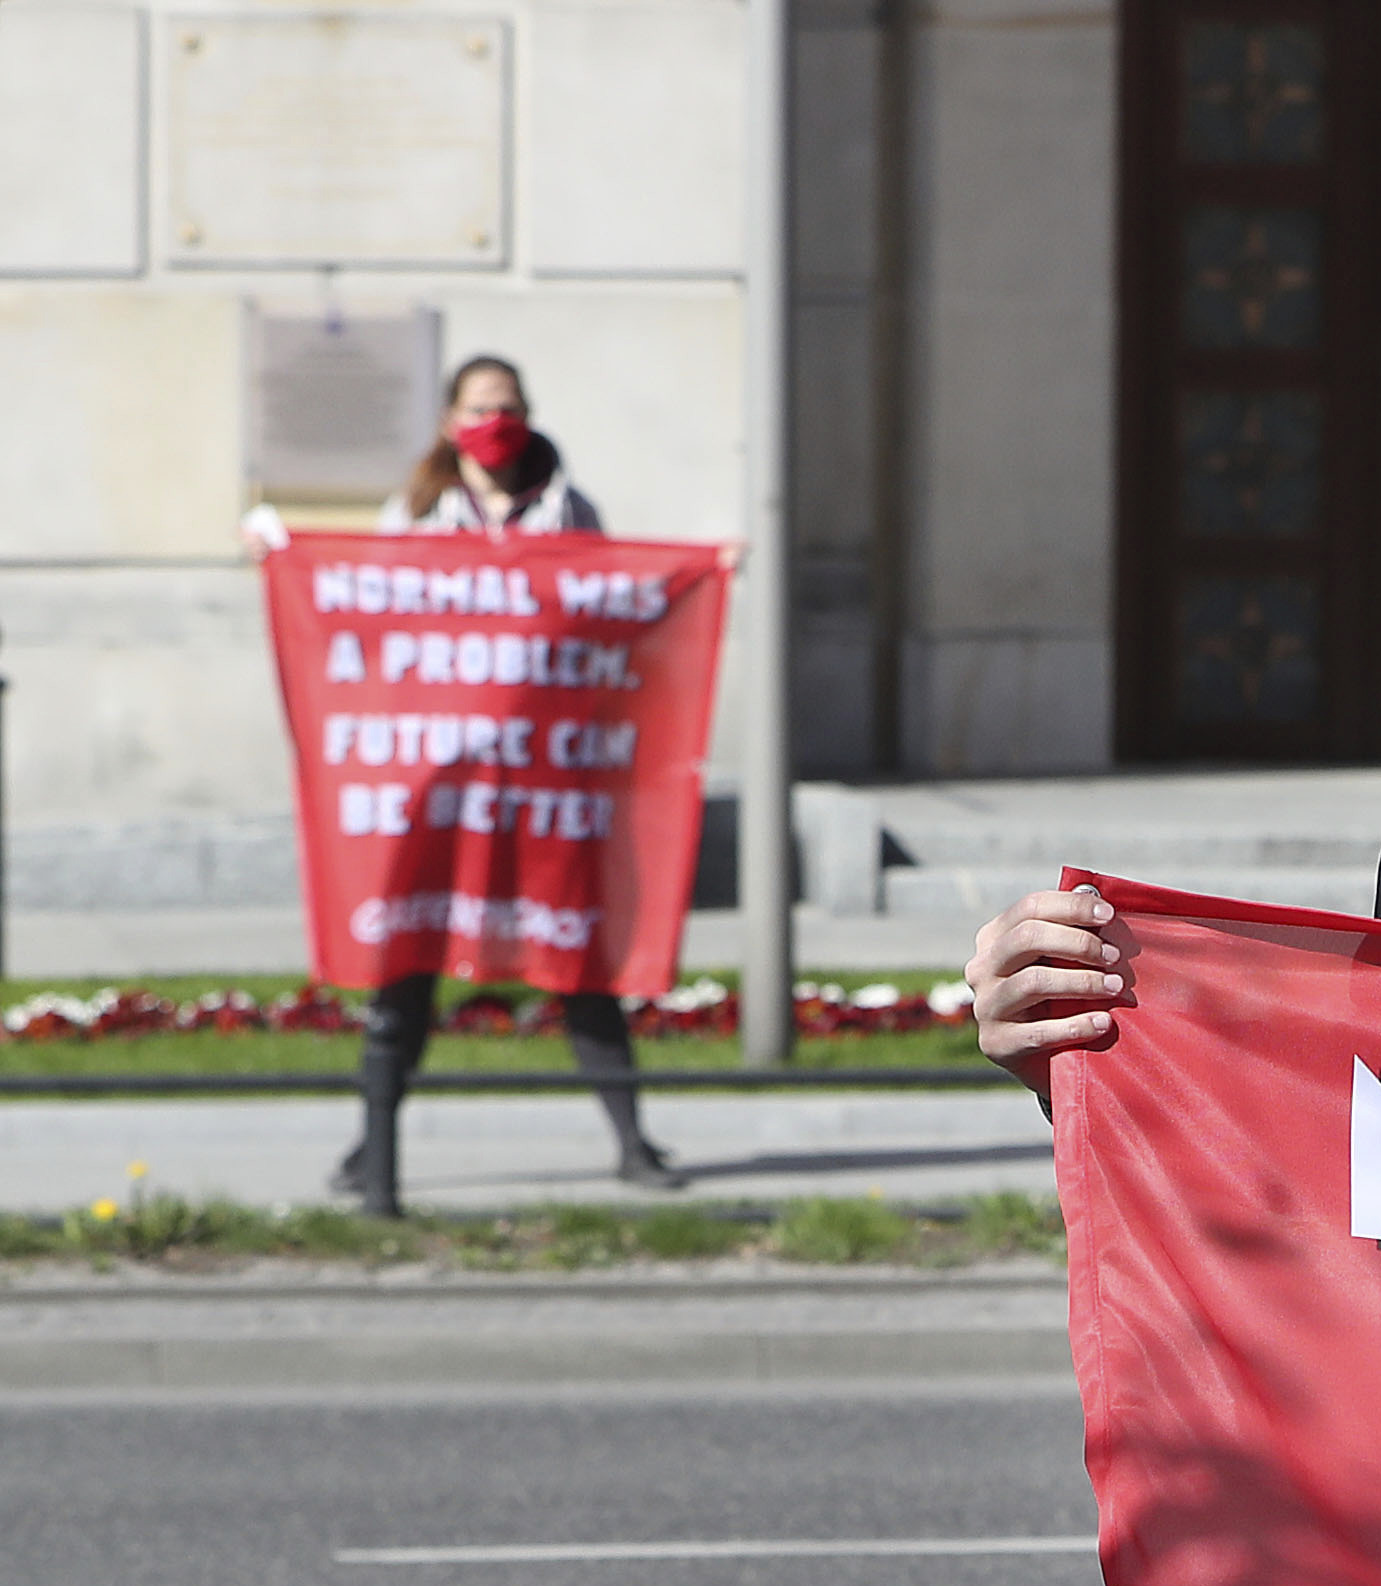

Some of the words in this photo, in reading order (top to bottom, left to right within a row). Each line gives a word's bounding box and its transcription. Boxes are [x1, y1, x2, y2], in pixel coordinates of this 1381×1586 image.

[313, 564, 539, 617] NORMAL
[556, 569, 668, 619] WAS
[327, 631, 365, 684] A
[382, 632, 643, 690] PROBLEM.
[323, 714, 534, 766] FUTURE
[548, 721, 637, 770] CAN
[339, 783, 410, 836] BE
